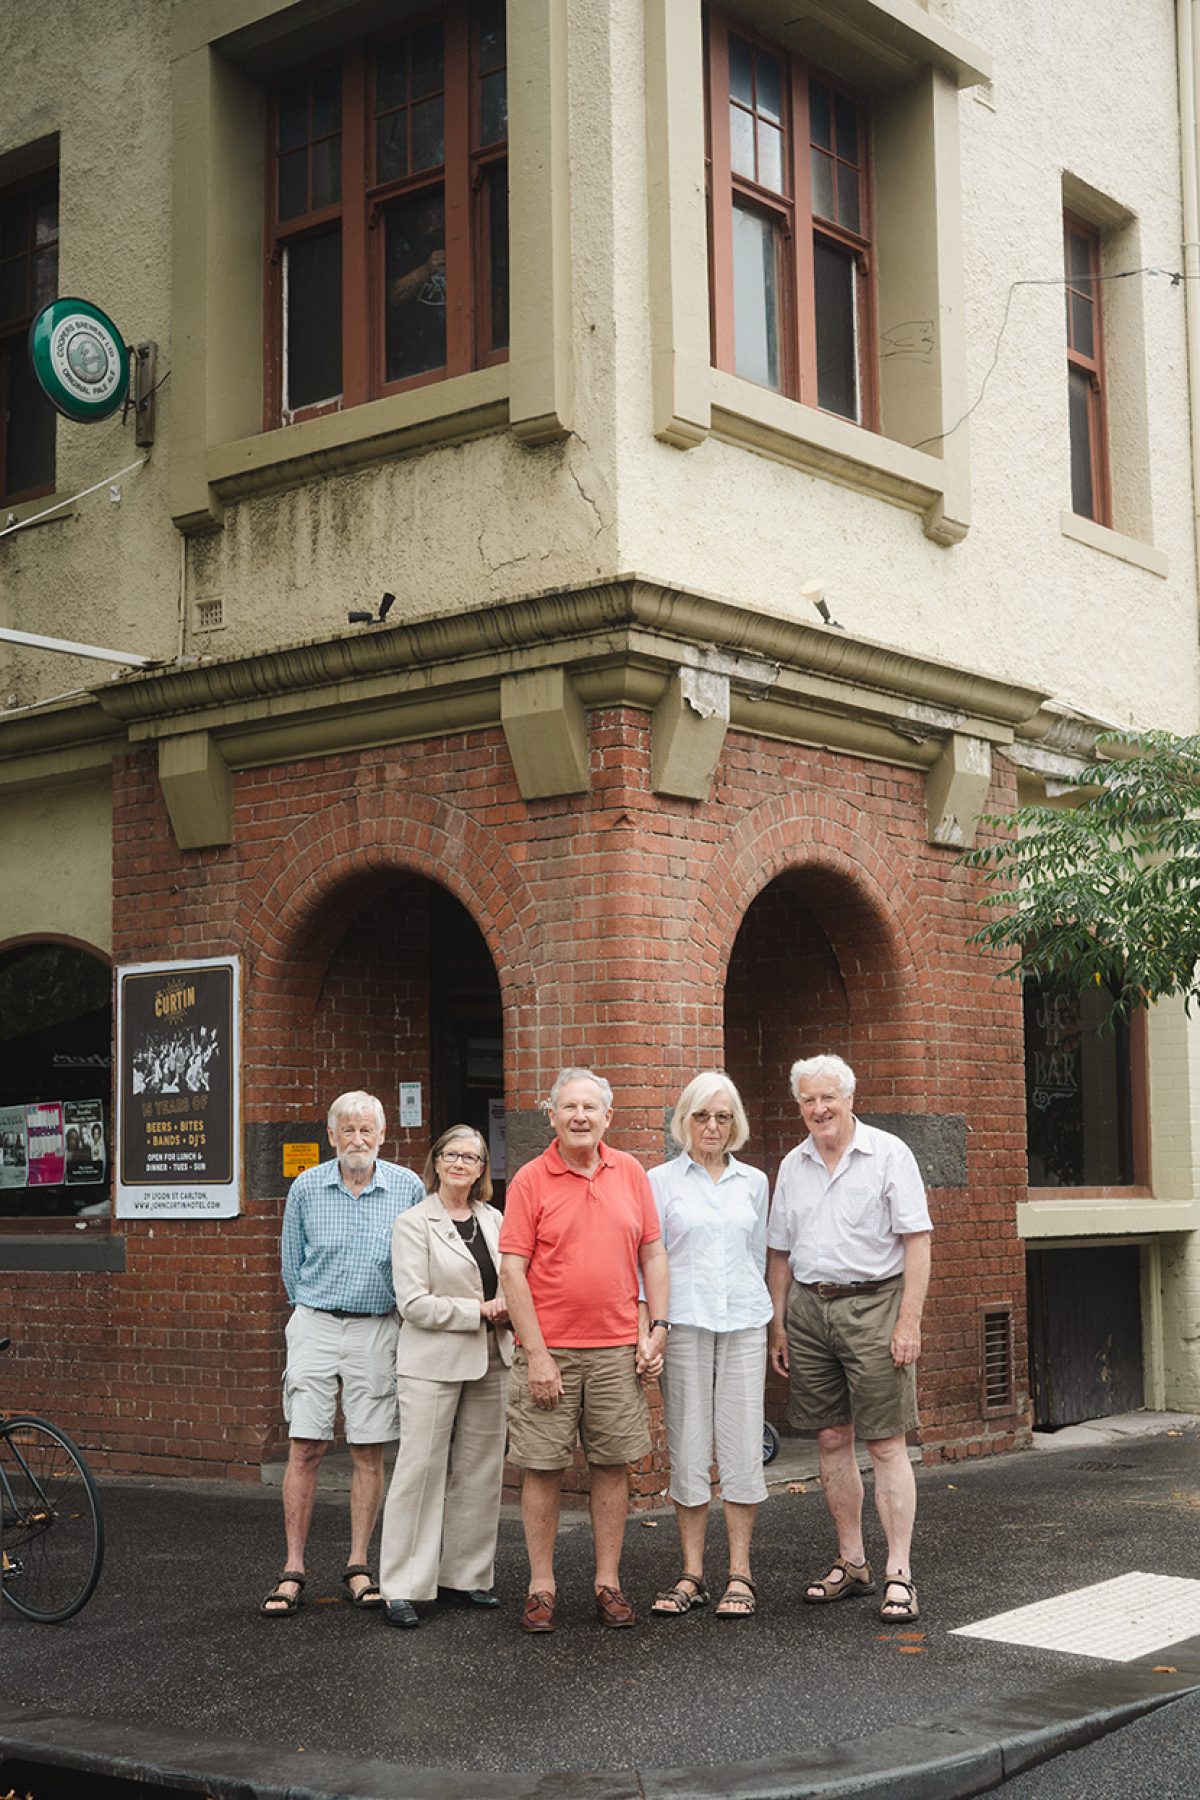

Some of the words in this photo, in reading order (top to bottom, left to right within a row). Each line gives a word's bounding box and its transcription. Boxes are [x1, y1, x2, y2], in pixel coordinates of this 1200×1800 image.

[56, 323, 75, 357] COOPERS
[75, 321, 106, 342] BREWERY
[62, 368, 91, 395] ORIGINAL
[92, 383, 108, 395] PALE
[107, 370, 116, 385] ALE
[155, 986, 196, 1017] CURTIN
[1032, 1051, 1078, 1087] BAR
[154, 1097, 190, 1115] YEARS
[191, 1094, 209, 1111] OF
[145, 1121, 172, 1133] BEERS
[180, 1120, 204, 1132] BITES
[152, 1134, 180, 1146] BANDS
[147, 1153, 163, 1162] OPEN
[164, 1153, 176, 1161] FOR
[176, 1152, 197, 1161] LUNCH
[145, 1163, 169, 1172] DINNER
[172, 1163, 189, 1171] TUES
[193, 1162, 206, 1171] SUN
[151, 1192, 170, 1200] LYGON
[171, 1192, 180, 1200] ST
